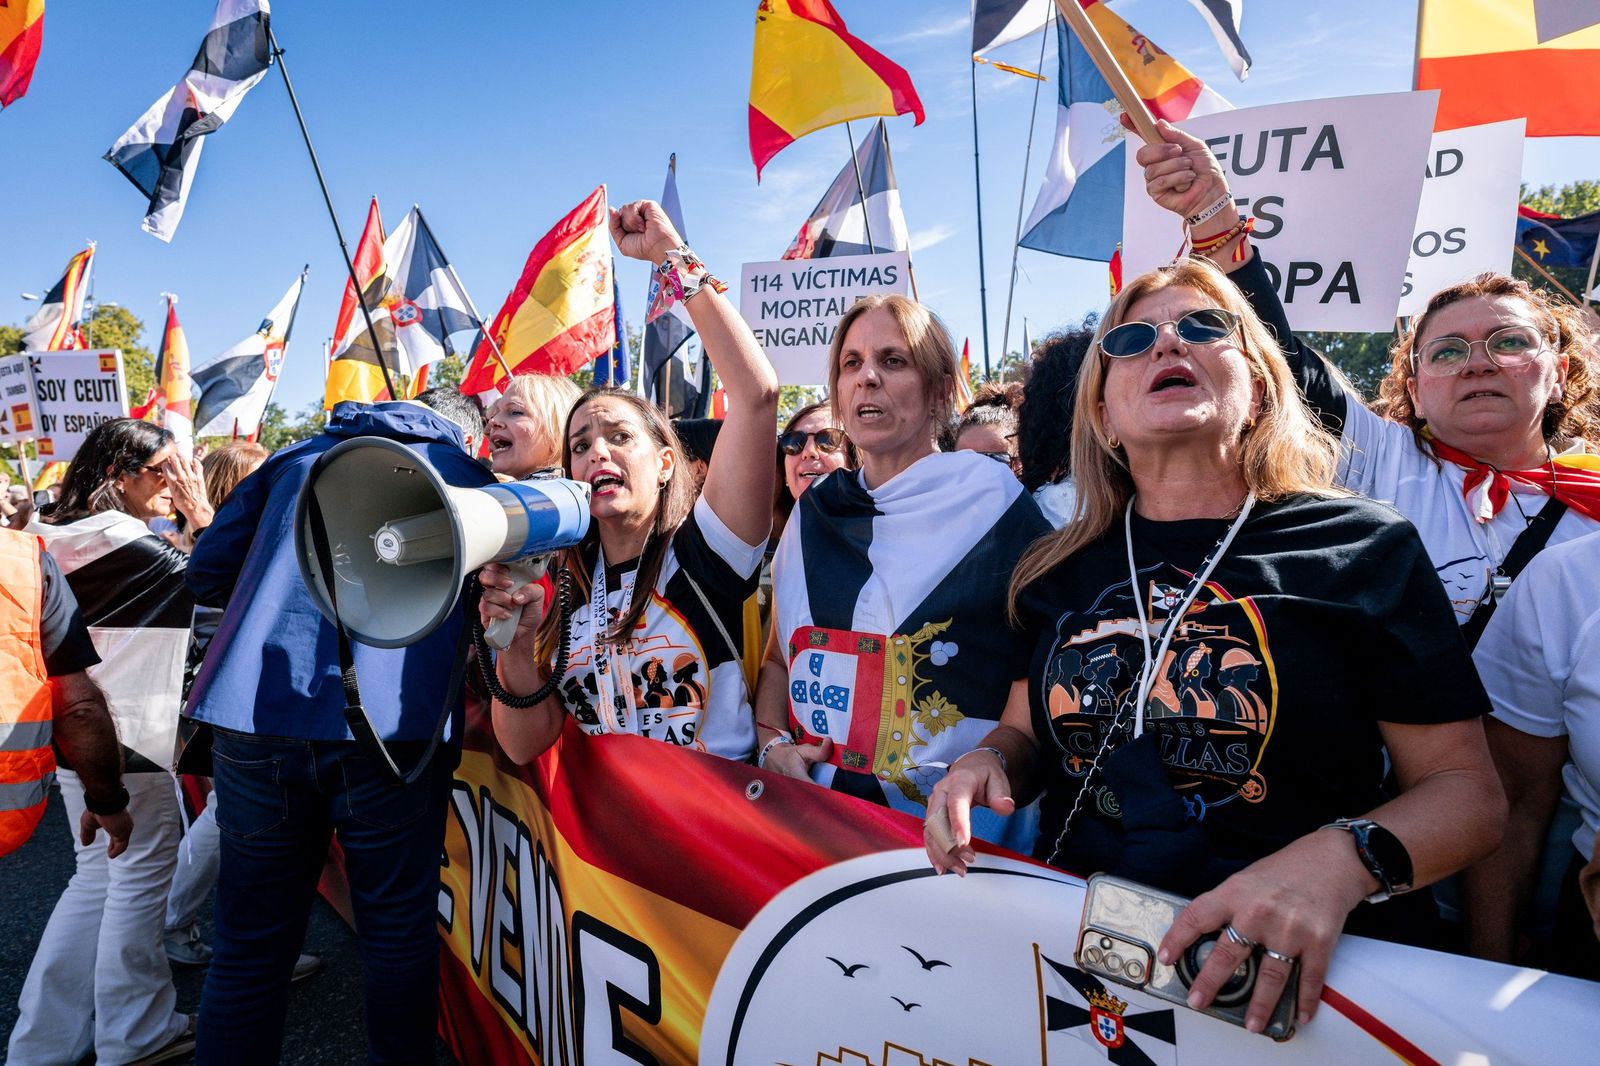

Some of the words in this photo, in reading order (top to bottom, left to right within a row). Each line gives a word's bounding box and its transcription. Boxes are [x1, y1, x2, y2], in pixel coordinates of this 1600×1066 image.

[1204, 124, 1345, 177] EUTA
[1425, 148, 1464, 179] D
[1233, 195, 1285, 240] S
[751, 273, 783, 293] 114
[792, 265, 898, 291] VÍCTIMAS
[761, 295, 869, 320] MORTAL
[37, 378, 66, 402] SOY
[74, 373, 119, 402] CEUTÍ
[41, 413, 57, 433] OY
[598, 572, 607, 627] CABALLAS
